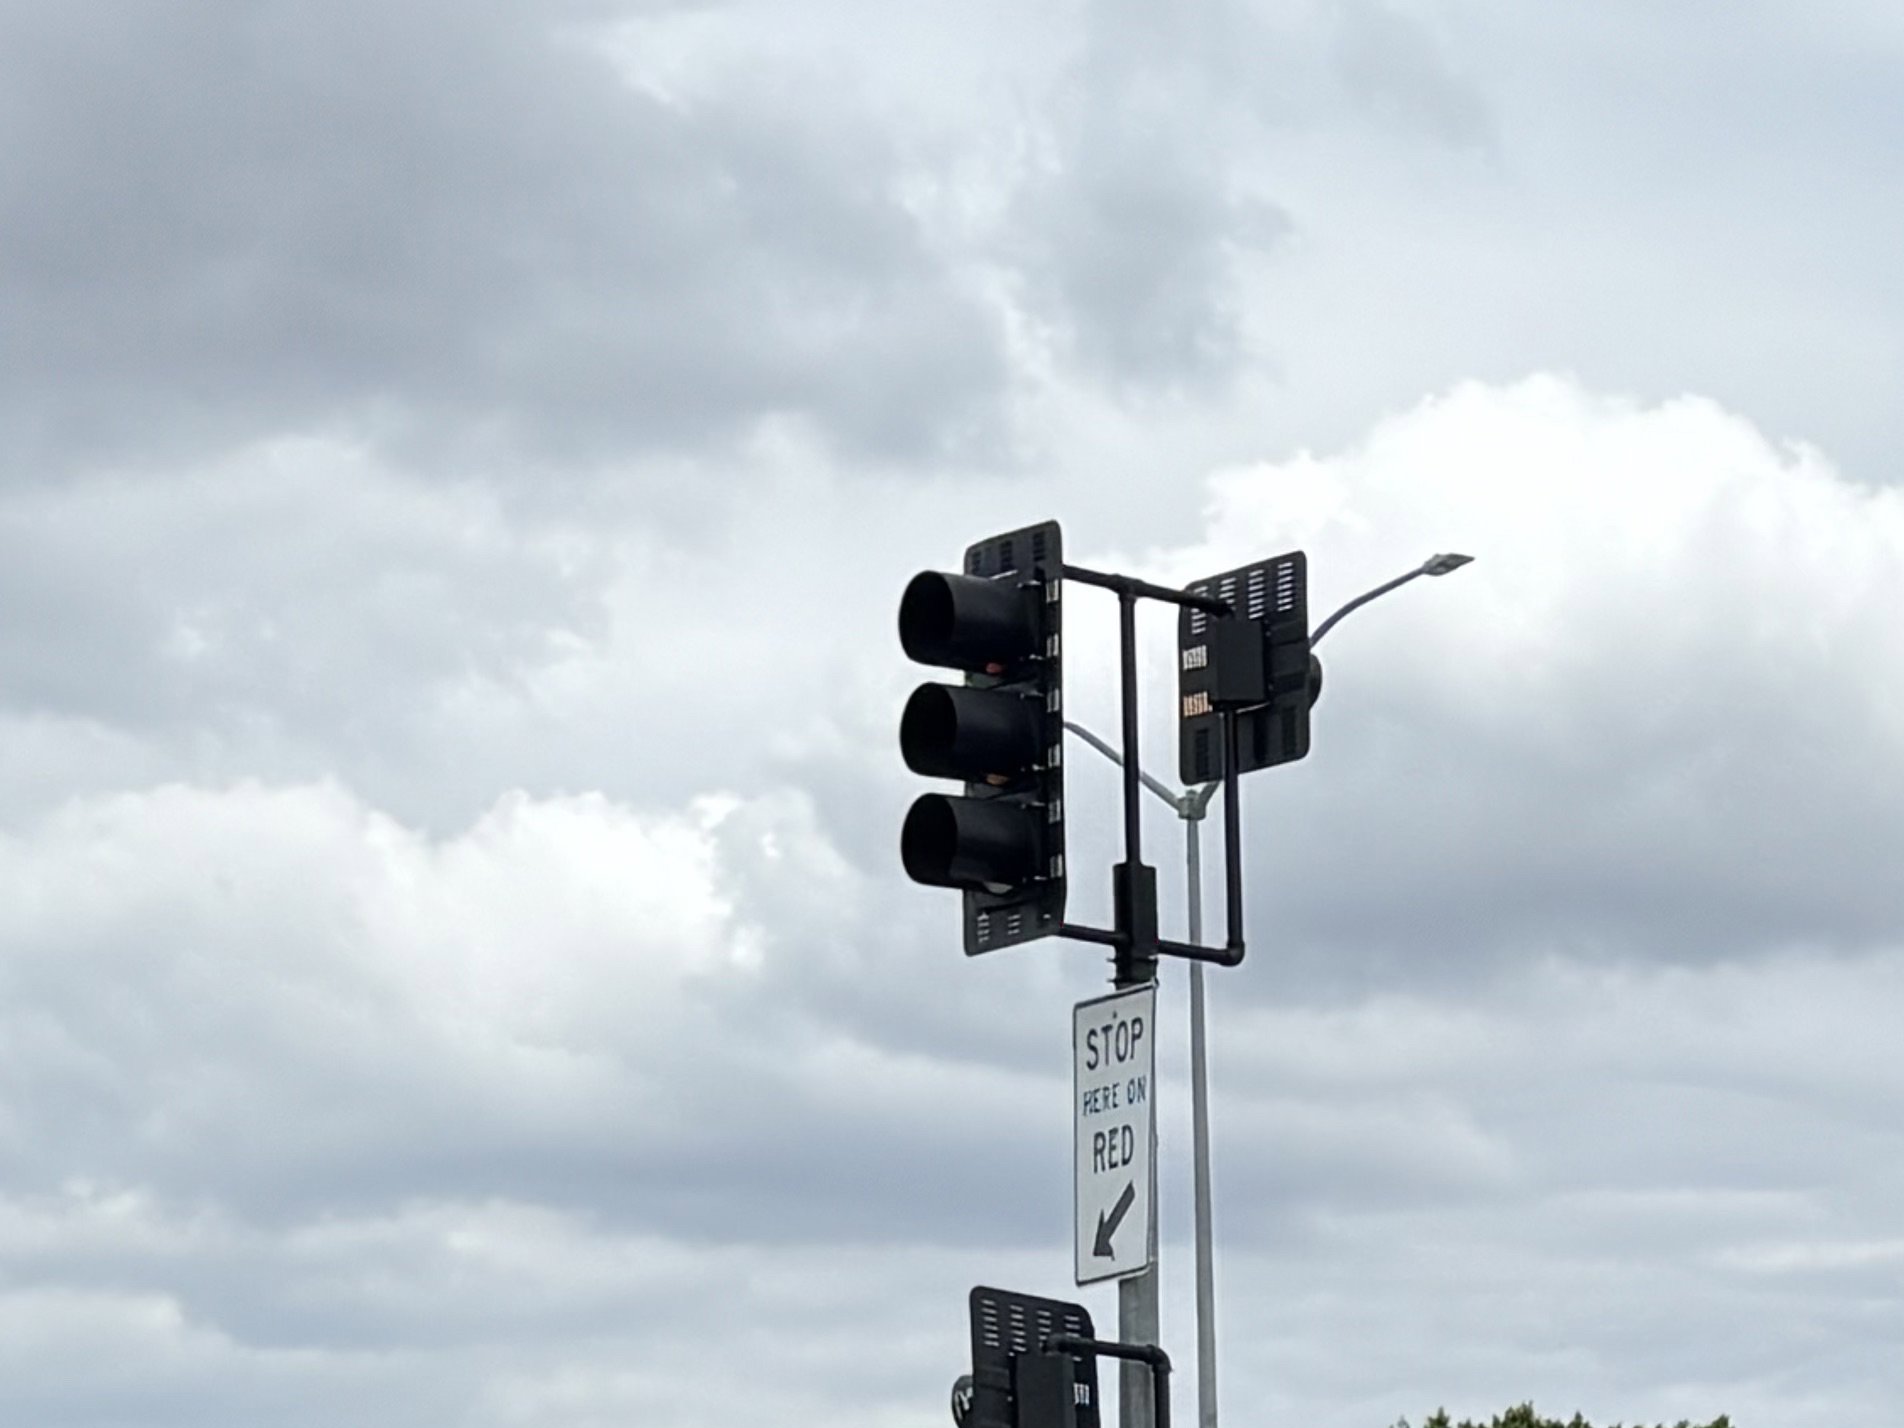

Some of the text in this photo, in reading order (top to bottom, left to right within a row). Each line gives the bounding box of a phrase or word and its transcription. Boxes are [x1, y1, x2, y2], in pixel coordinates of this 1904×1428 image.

[1086, 1017, 1143, 1070] STOP
[1083, 1075, 1147, 1116] HERE ON
[1093, 1124, 1134, 1174] RED
